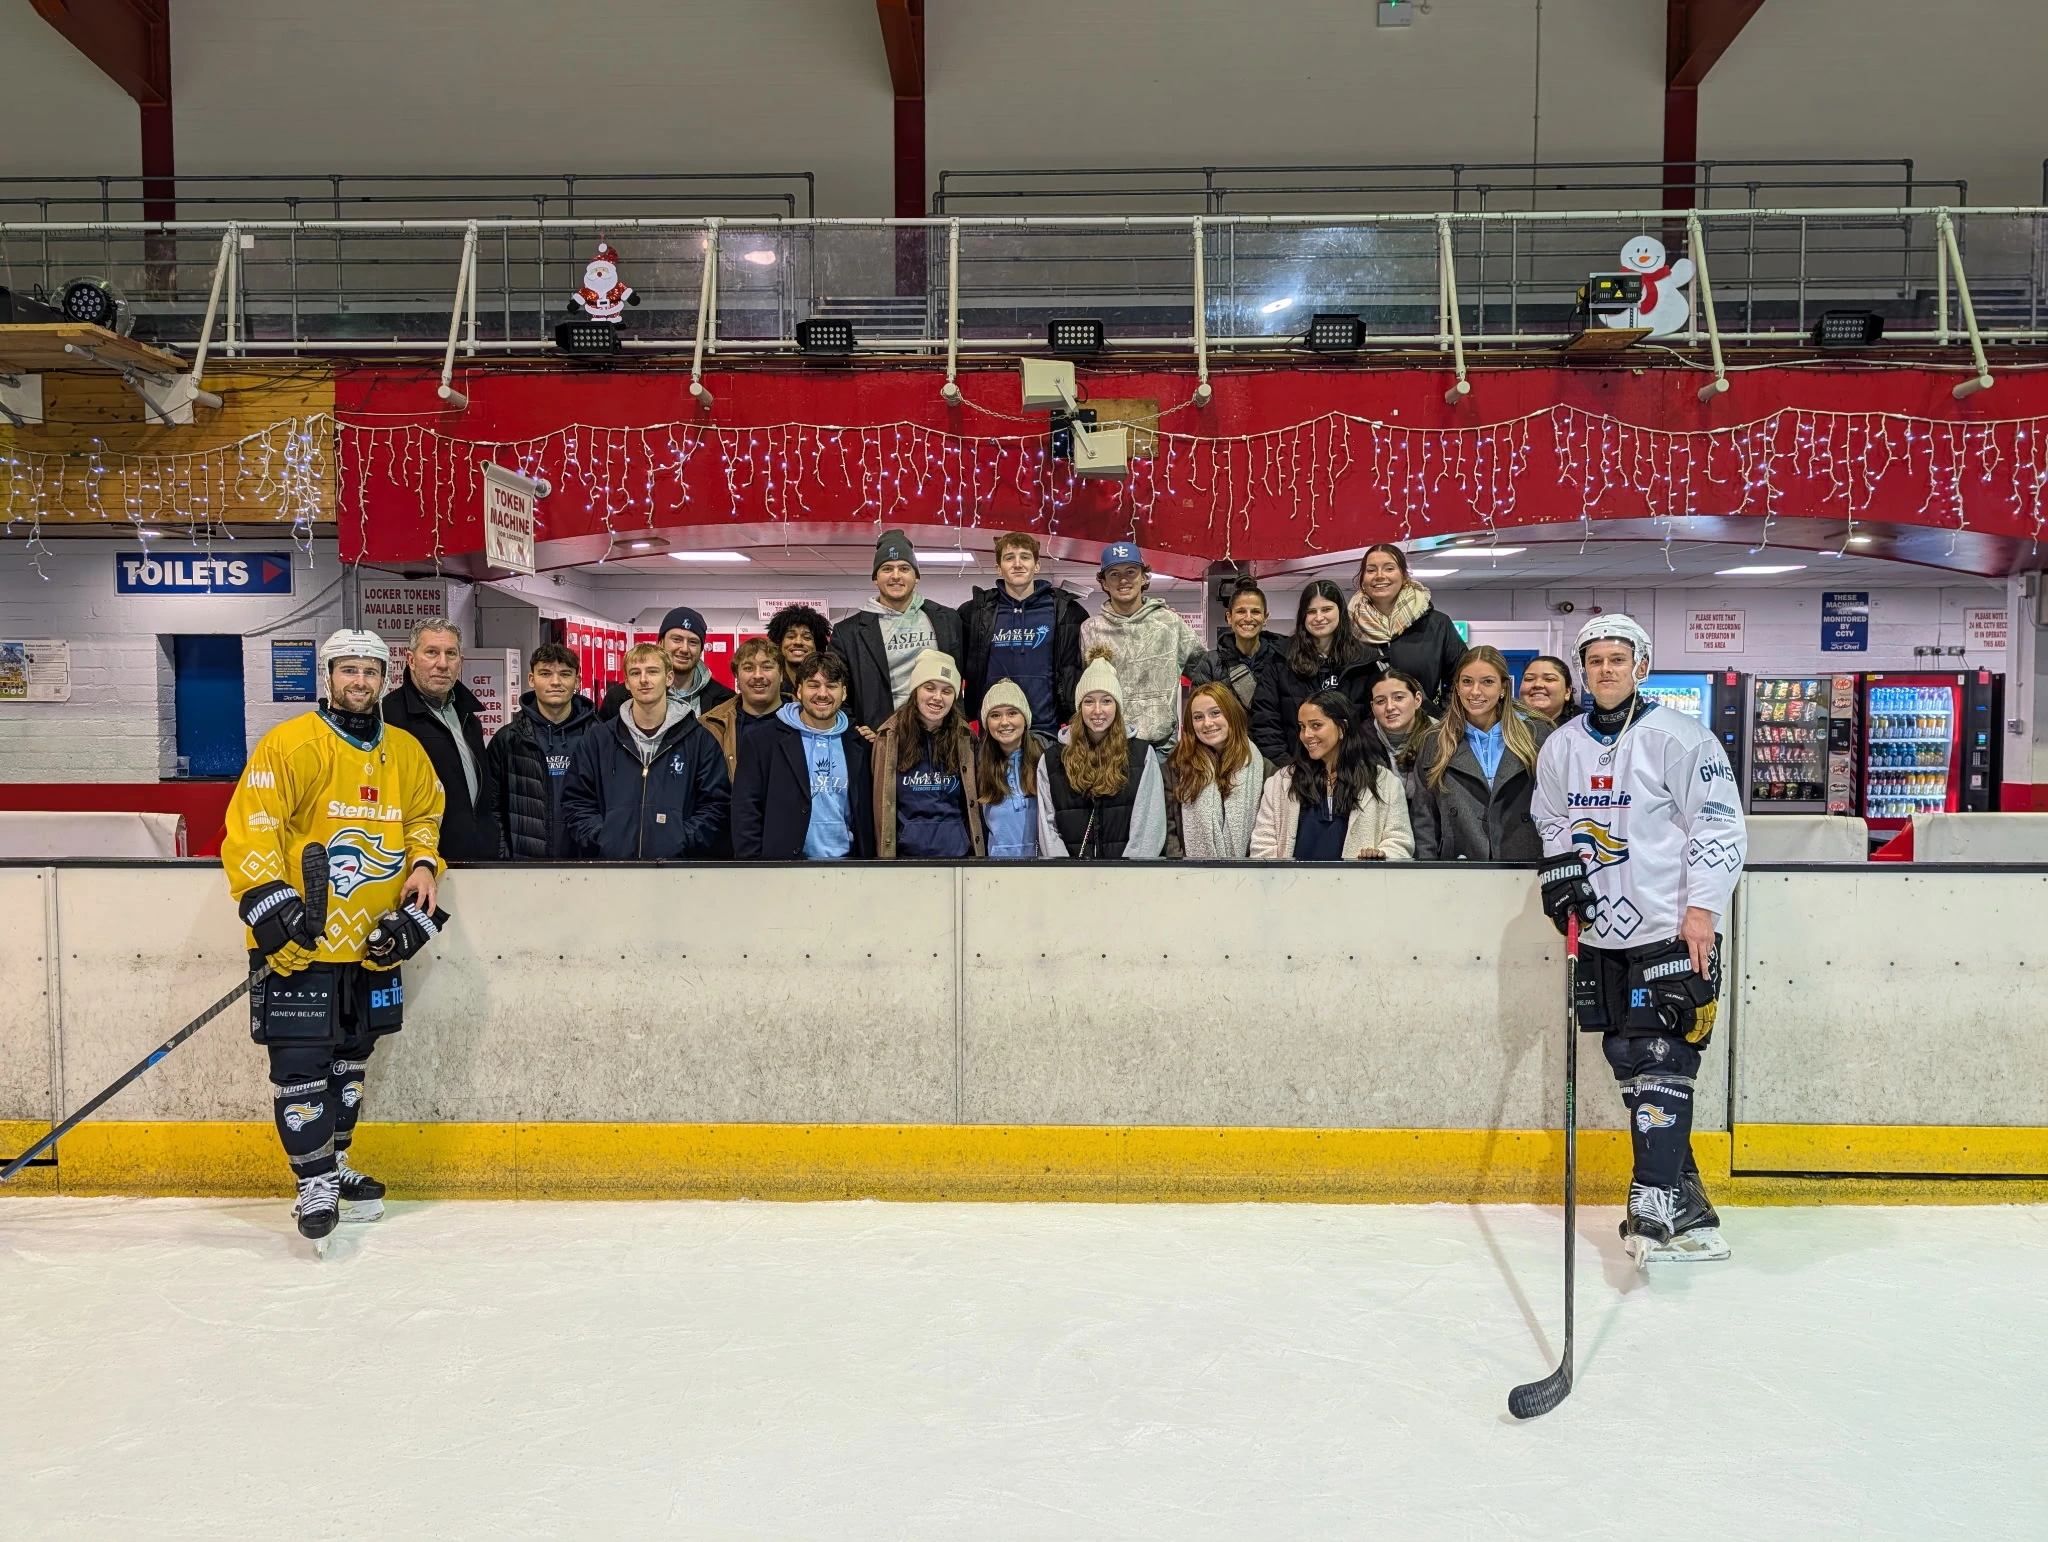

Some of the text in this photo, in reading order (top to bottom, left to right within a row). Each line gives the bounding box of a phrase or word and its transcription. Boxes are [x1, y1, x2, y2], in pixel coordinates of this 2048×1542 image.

[495, 488, 525, 514] TOKEN
[490, 508, 530, 535] MACHINE
[123, 560, 249, 586] TOILETS
[364, 588, 440, 600] LOCKER TOKENS
[364, 604, 440, 615] AVAILABLE HERE
[377, 618, 421, 630] £1.00 EA
[886, 631, 938, 645] ASELL
[888, 640, 930, 650] BASEBALL
[472, 676, 492, 684] GET
[472, 688, 496, 698] OUR
[482, 702, 502, 710] KER
[476, 714, 502, 724] KENS
[482, 728, 495, 736] RE
[1598, 778, 1604, 788] S
[368, 788, 372, 800] S
[1568, 793, 1610, 807] Stena
[328, 800, 402, 820] Stena Lin
